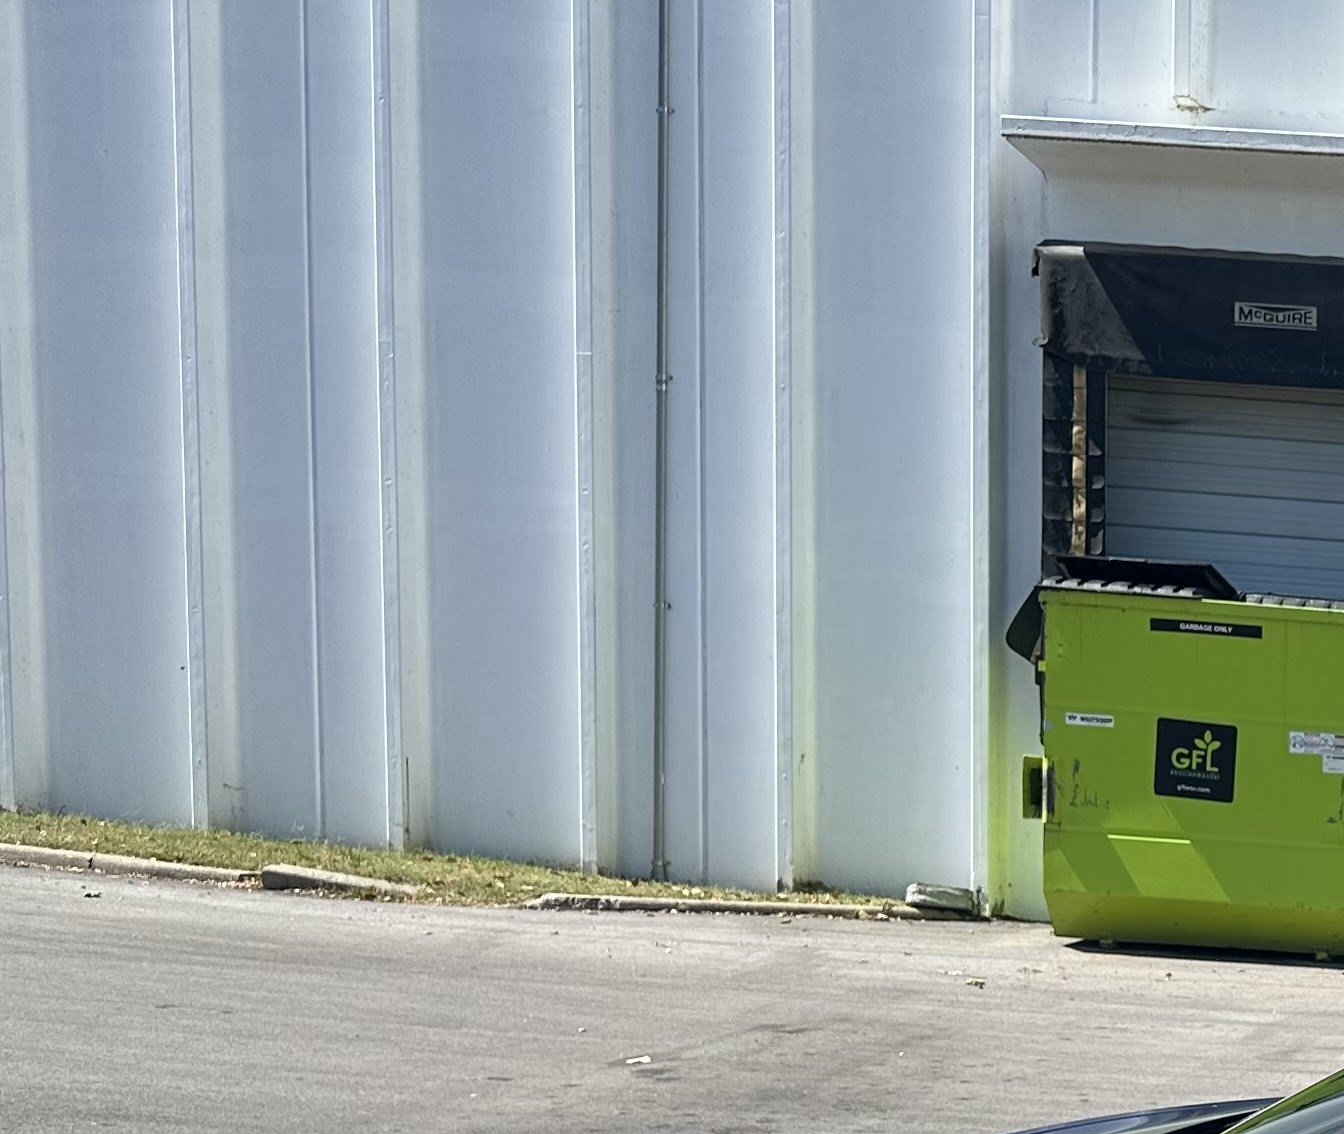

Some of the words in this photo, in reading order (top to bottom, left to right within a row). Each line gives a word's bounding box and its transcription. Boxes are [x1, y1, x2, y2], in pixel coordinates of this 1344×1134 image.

[1179, 622, 1212, 632] GARBAGE
[1213, 625, 1234, 634] ONLY
[1171, 738, 1220, 772] GFL
